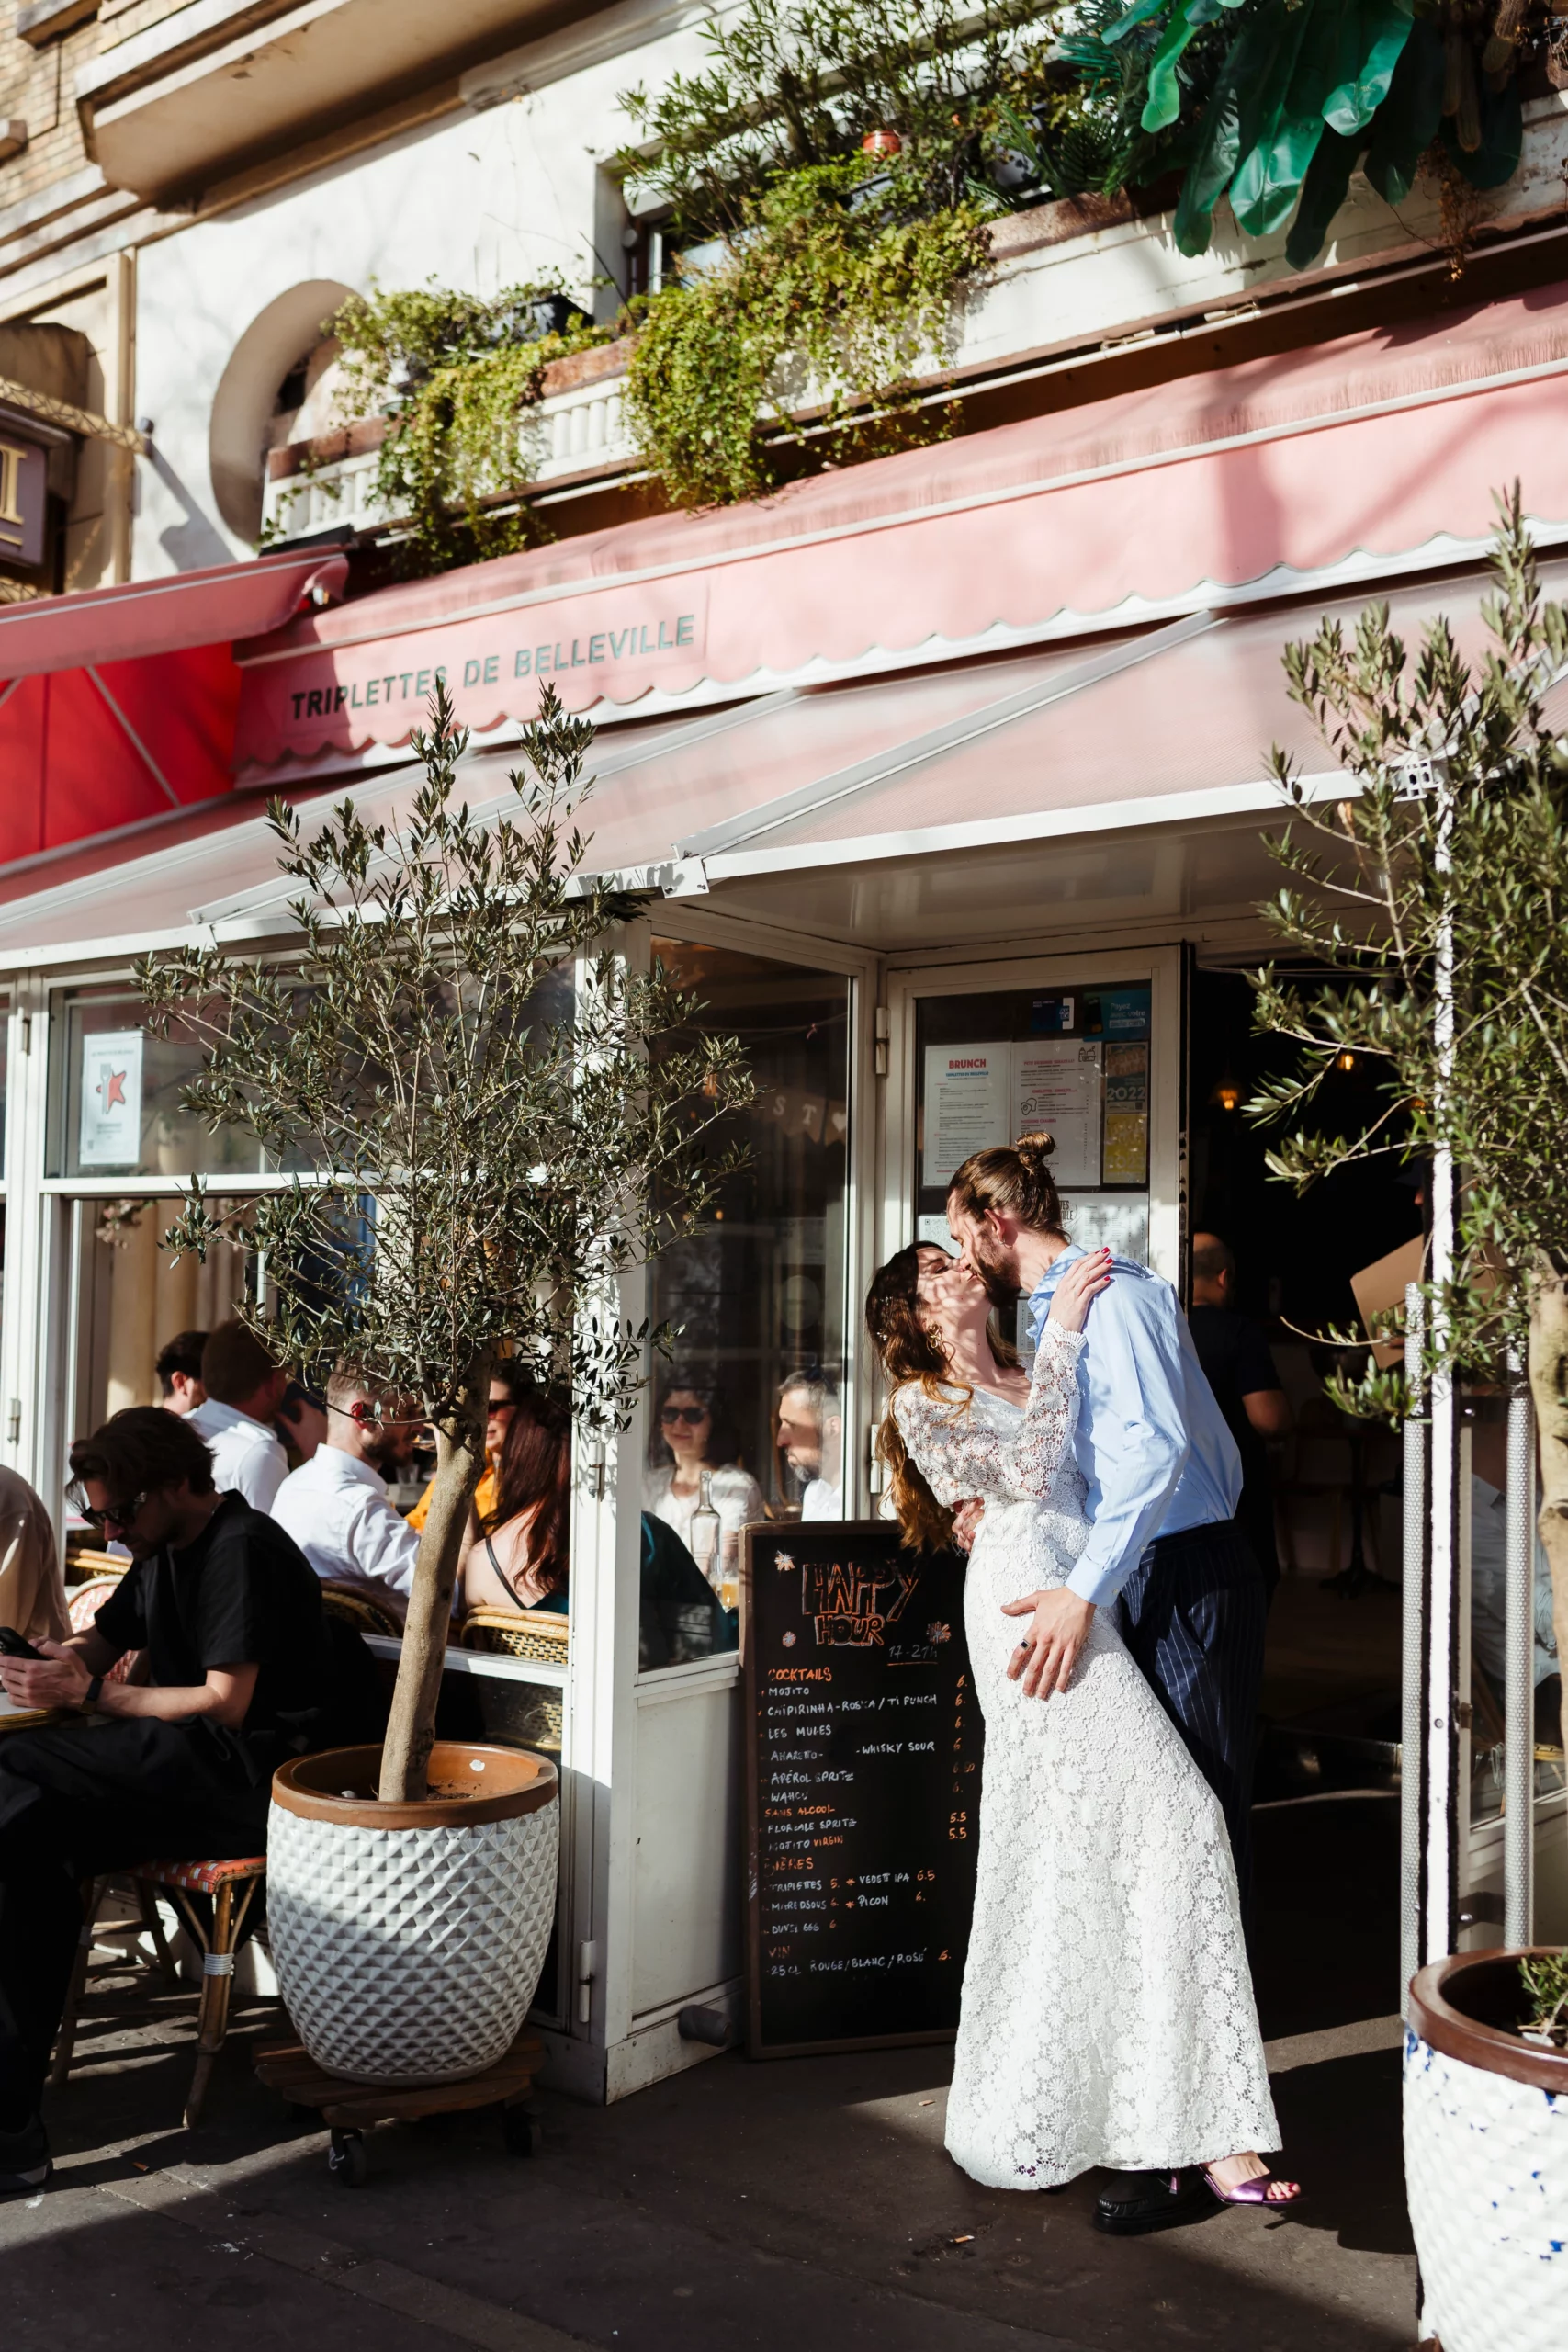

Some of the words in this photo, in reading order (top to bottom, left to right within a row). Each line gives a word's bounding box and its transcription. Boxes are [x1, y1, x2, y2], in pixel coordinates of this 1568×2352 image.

[291, 666, 447, 720] TRIPLETTES
[464, 656, 500, 688] DE
[514, 615, 694, 678] BELLEVILLE
[949, 1058, 987, 1069] BRUNCH
[1107, 1086, 1146, 1101] 2022
[802, 1559, 922, 1622] HAPPY
[814, 1614, 885, 1647] HOUR
[768, 1667, 832, 1682] COCKTAILS
[769, 1687, 810, 1697] MOJITO
[903, 1694, 937, 1706] PUNCH
[768, 1728, 787, 1740] LES
[796, 1724, 832, 1736] MULES
[908, 1741, 935, 1752] SOUR
[764, 1806, 793, 1817] SANS
[797, 1804, 836, 1815] ALCOOL
[820, 1818, 857, 1829] SPRITZ
[950, 1811, 967, 1823] 5.5
[948, 1827, 967, 1839] 5.5
[859, 1873, 891, 1885] VEDETT
[894, 1872, 910, 1883] IPA
[857, 1894, 889, 1907] PICON
[803, 1921, 820, 1932] 666
[768, 1945, 791, 1960] VIN
